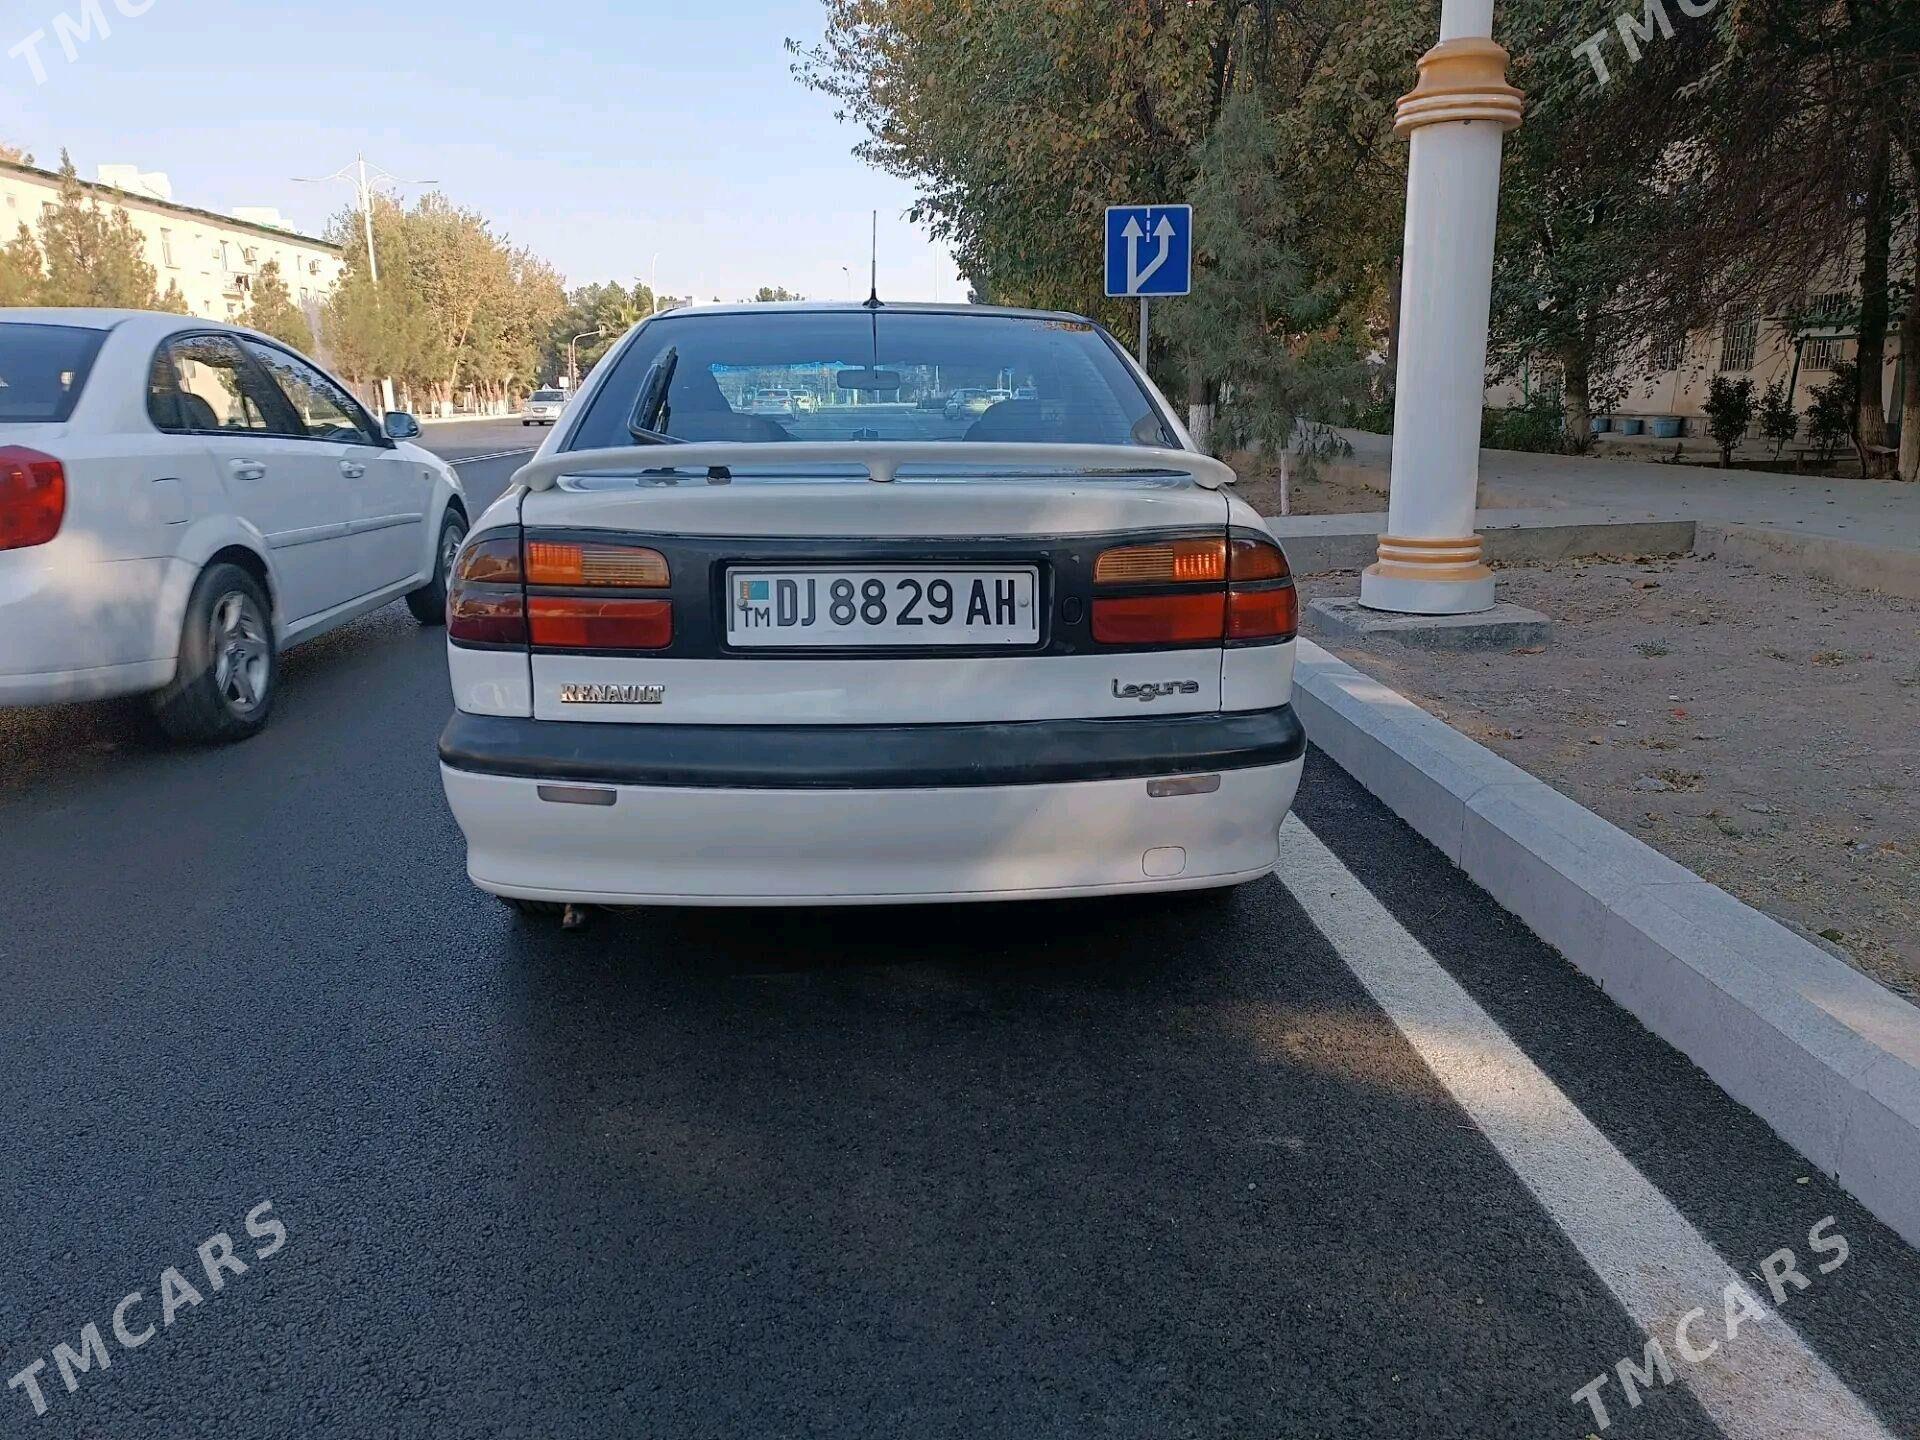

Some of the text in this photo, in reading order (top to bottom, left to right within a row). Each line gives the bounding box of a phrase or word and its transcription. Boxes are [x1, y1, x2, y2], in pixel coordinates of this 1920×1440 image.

[742, 578, 1016, 628] TM DJ 8829 AH
[561, 684, 664, 703] RENAULT
